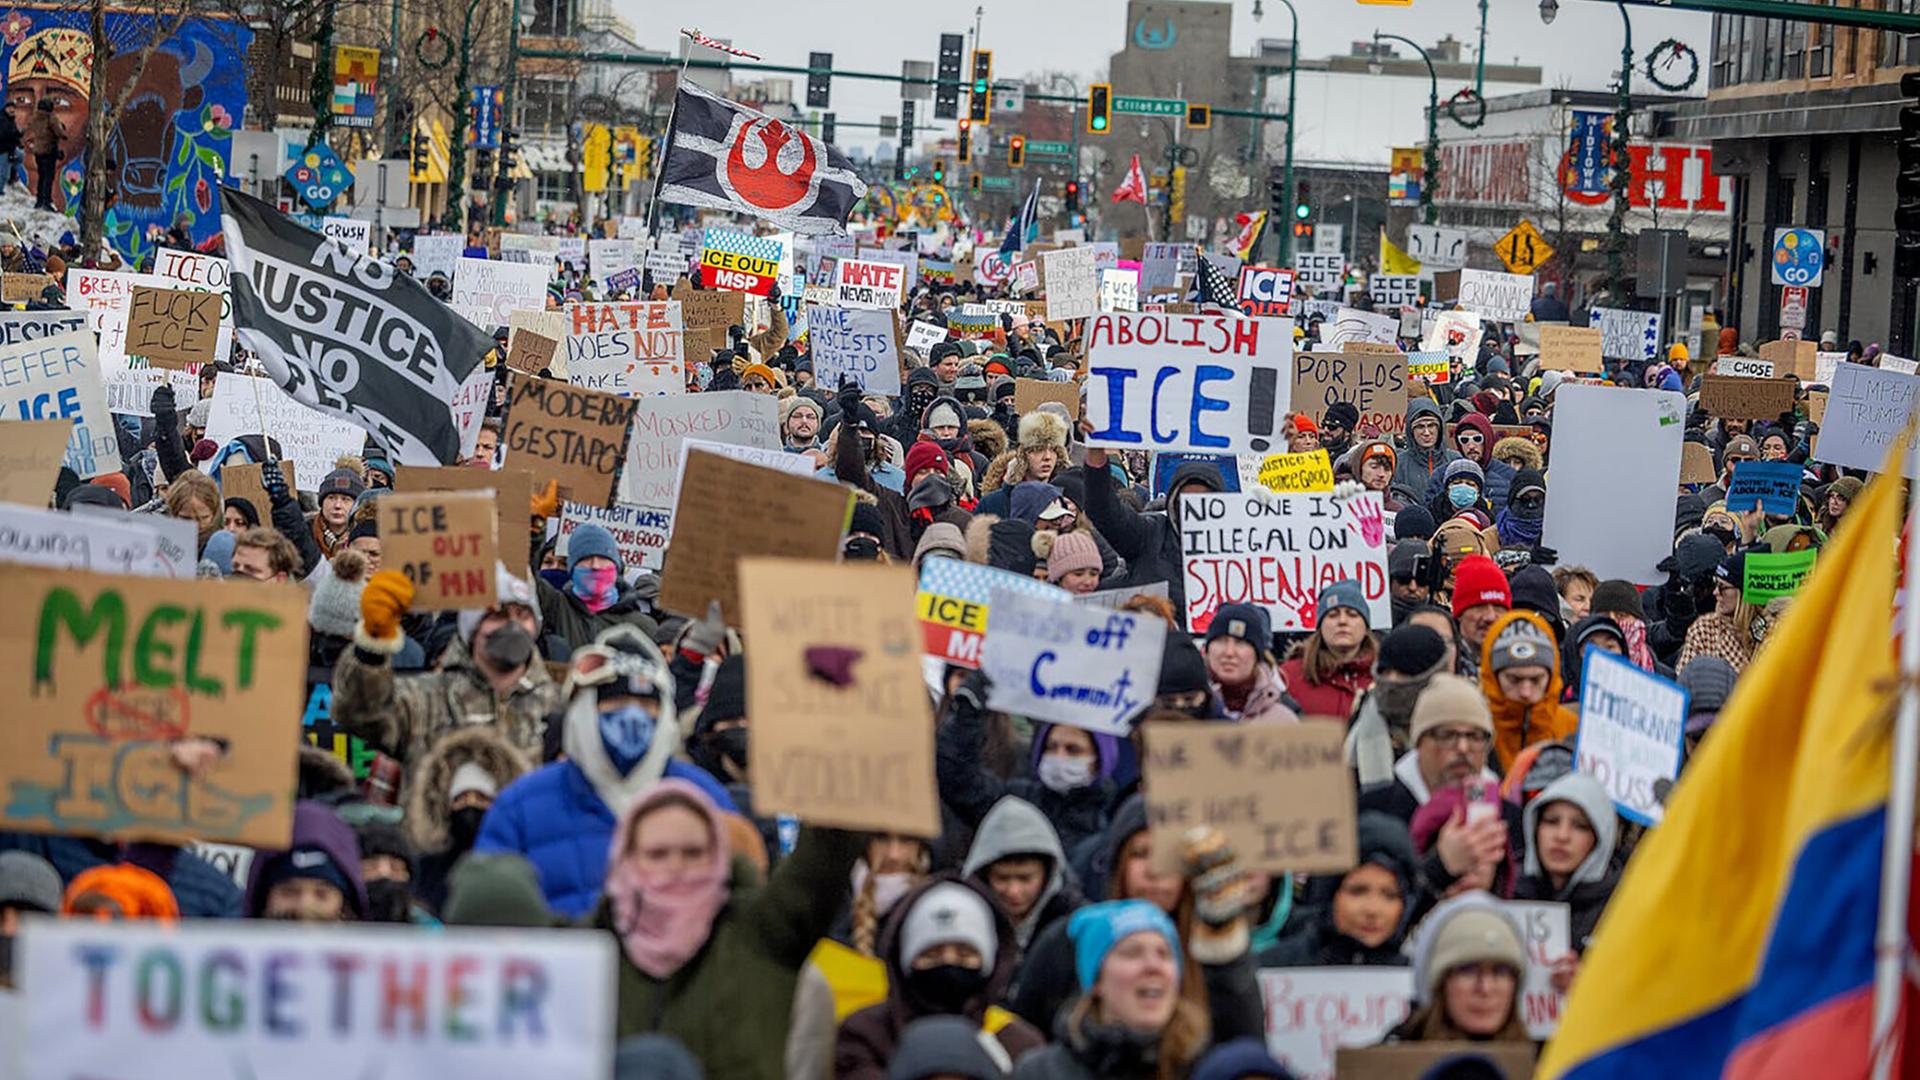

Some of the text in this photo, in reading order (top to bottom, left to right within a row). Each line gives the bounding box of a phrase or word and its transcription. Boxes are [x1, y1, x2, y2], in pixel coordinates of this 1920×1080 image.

[351, 117, 373, 127] STREET
[1583, 115, 1598, 189] MIDTOWN
[306, 186, 331, 200] GO
[325, 224, 364, 241] CRUSH
[162, 253, 205, 283] ICE
[703, 250, 777, 275] ICE OUT
[1299, 256, 1340, 269] ICE
[1785, 268, 1808, 282] GO
[715, 269, 759, 290] MSP
[843, 262, 900, 289] HATE
[1244, 270, 1292, 302] ICE
[1299, 272, 1339, 284] OUT
[1374, 278, 1416, 290] ICE
[840, 286, 872, 303] NEVER
[1103, 281, 1136, 297] FUCK
[1374, 293, 1416, 305] OUT
[1461, 281, 1530, 312] CRIMINALS
[88, 298, 121, 309] THE
[132, 291, 211, 327] FUCK
[987, 302, 1024, 317] ICE OUT
[572, 304, 670, 335] HATE
[915, 326, 941, 338] ICE OUT
[970, 323, 991, 333] OUT
[136, 321, 204, 352] ICE
[566, 331, 681, 361] DOES NOT
[812, 327, 887, 353] FASCISTS
[1090, 315, 1259, 356] ABOLISH
[0, 347, 86, 387] EFER
[518, 350, 541, 372] ICE
[815, 349, 877, 372] AFRAID
[1407, 364, 1444, 374] CE OUT
[1733, 361, 1774, 378] CHOSE
[571, 374, 627, 389] MAKE
[1297, 356, 1403, 392] POR LOS
[19, 387, 84, 424] ICE
[513, 378, 638, 426] MODERN
[751, 398, 763, 414] I
[1088, 364, 1278, 452] ICE!
[1324, 385, 1374, 412] QUE
[509, 422, 626, 474] GESTAPO
[1732, 487, 1794, 498] ABOLISH ICE
[1734, 479, 1768, 488] PROTECT
[389, 505, 447, 536] ICE
[1185, 497, 1342, 521] NO ONE IS
[433, 534, 481, 557] OUT
[1185, 527, 1347, 555] ILLEGAL ON
[404, 561, 487, 597] OF MN
[1187, 556, 1300, 612] STOLEN
[1748, 573, 1789, 581] PROTECT
[1748, 581, 1795, 591] ABOLISH
[928, 597, 979, 628] ICE
[34, 586, 285, 696] MELT
[1086, 616, 1136, 648] off
[1262, 820, 1336, 860] ICE
[72, 945, 553, 1042] TOGETHER
[1264, 973, 1411, 1035] Brown
